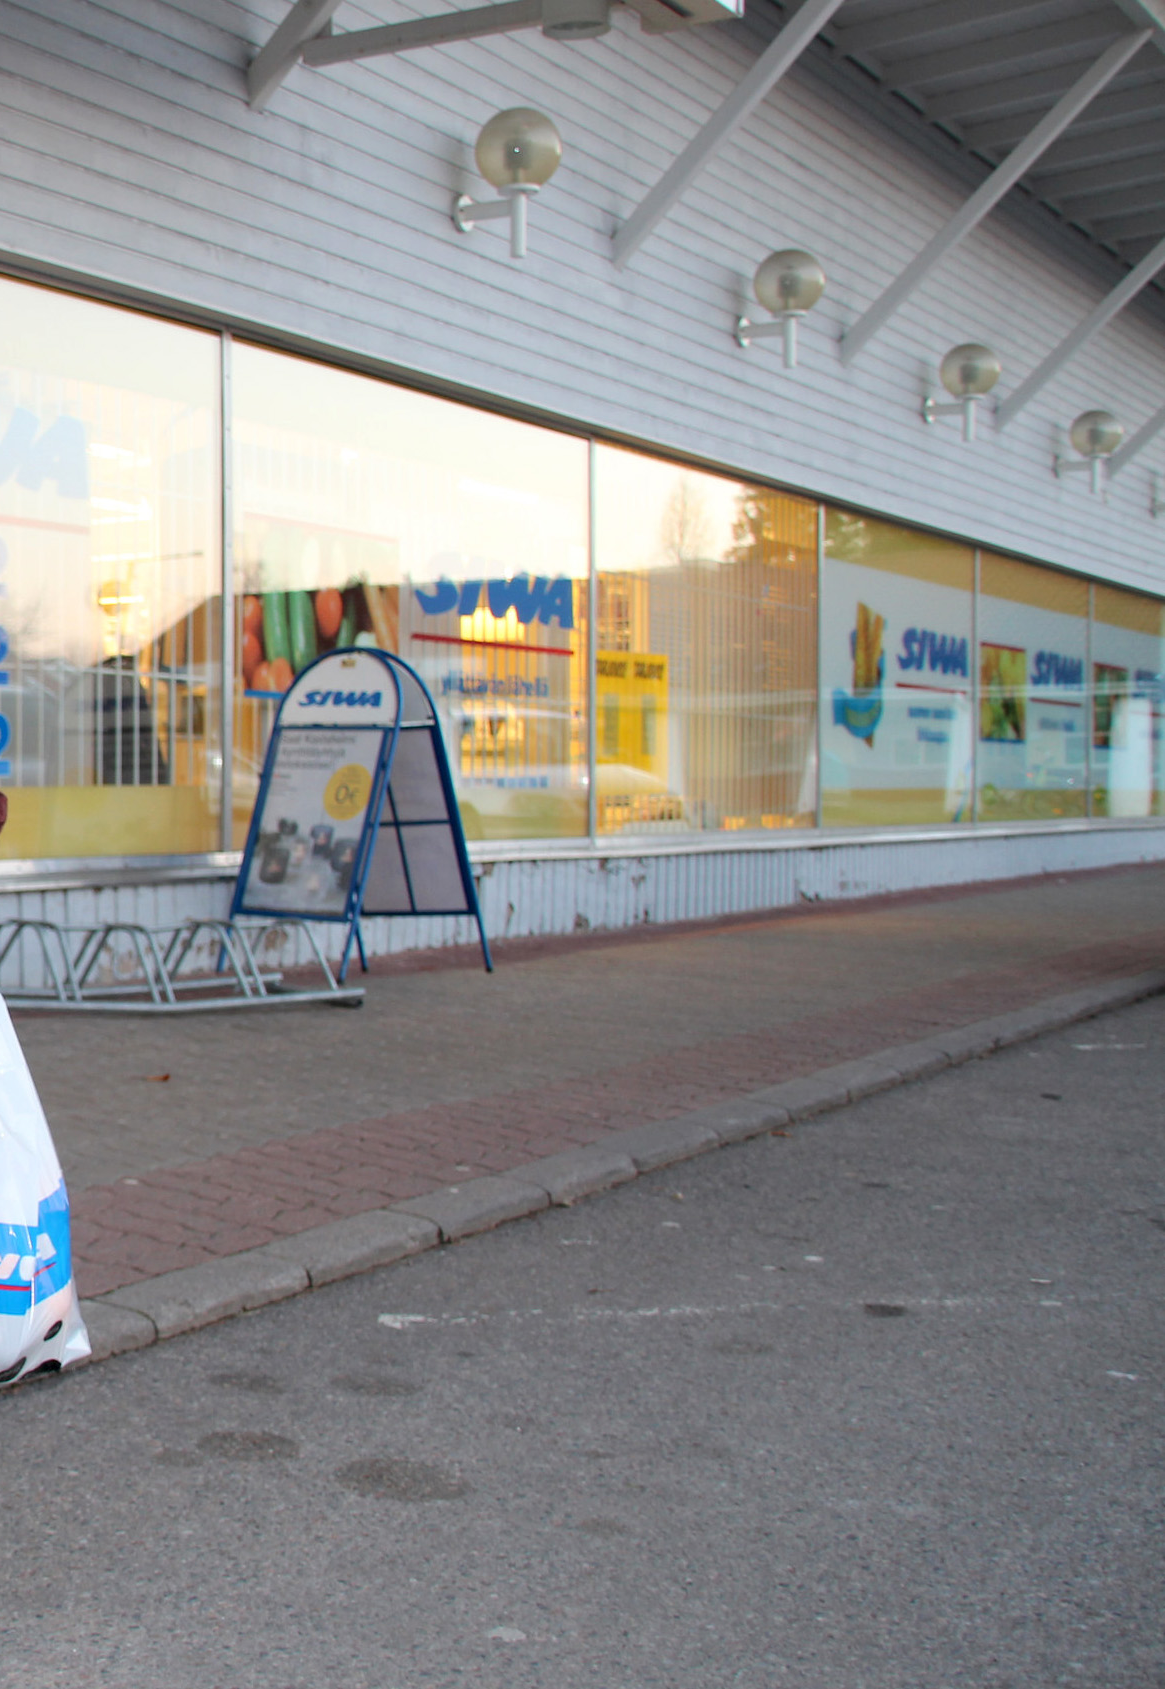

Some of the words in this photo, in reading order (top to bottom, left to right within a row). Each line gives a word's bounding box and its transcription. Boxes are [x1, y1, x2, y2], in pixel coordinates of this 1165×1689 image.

[897, 627, 968, 678] SIWA
[1030, 651, 1083, 688] SIWA
[299, 690, 382, 708] SIWA
